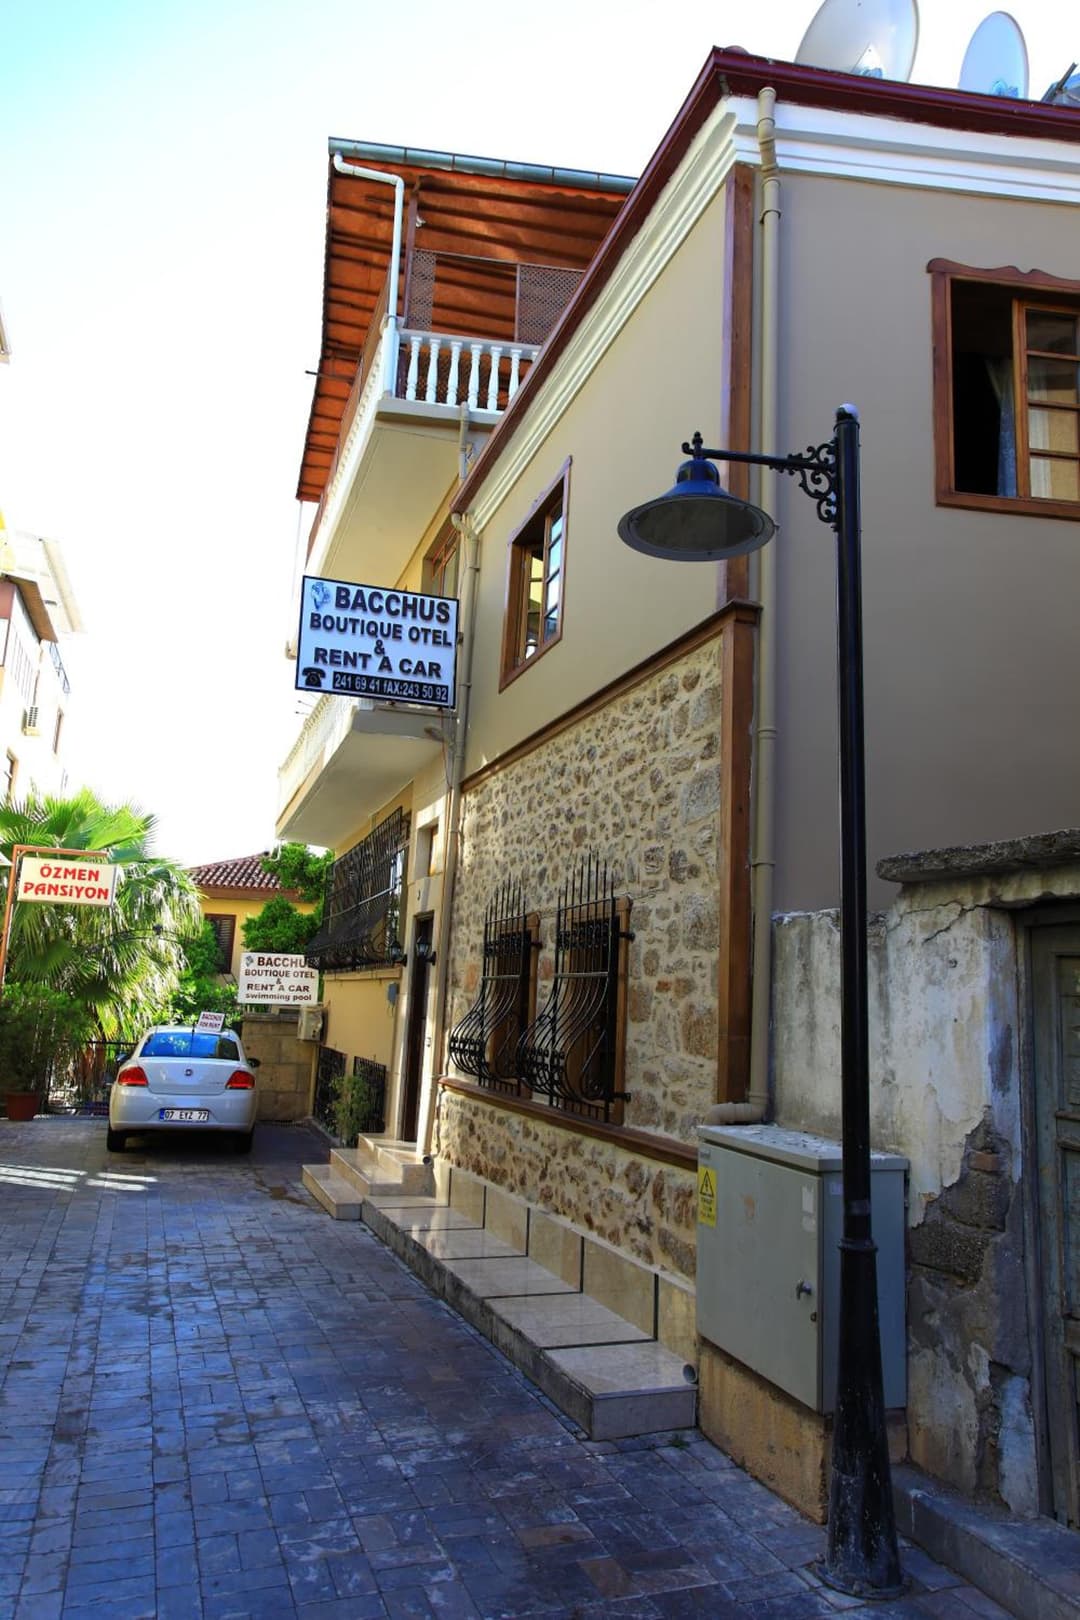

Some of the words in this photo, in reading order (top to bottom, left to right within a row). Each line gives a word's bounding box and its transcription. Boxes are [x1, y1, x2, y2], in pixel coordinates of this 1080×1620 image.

[335, 586, 450, 624] BACCHUS
[309, 612, 402, 640] BOUTIQUE
[408, 626, 452, 647] OTEL
[374, 639, 385, 655] &
[314, 647, 372, 670] RENT
[378, 656, 393, 672] A
[399, 658, 442, 679] CAR
[335, 672, 352, 689] 241
[355, 677, 367, 690] 69
[369, 679, 380, 693] 41
[422, 685, 433, 699] 50
[436, 687, 448, 701] 92
[40, 864, 100, 882] ÖZMEN
[257, 956, 307, 969] BACCHU
[245, 969, 290, 978] BOUTIQUE
[293, 970, 315, 979] OTEL
[247, 983, 275, 991] RENT
[245, 992, 290, 1001] swimming
[293, 993, 312, 1002] pool
[165, 1111, 175, 1119] 07
